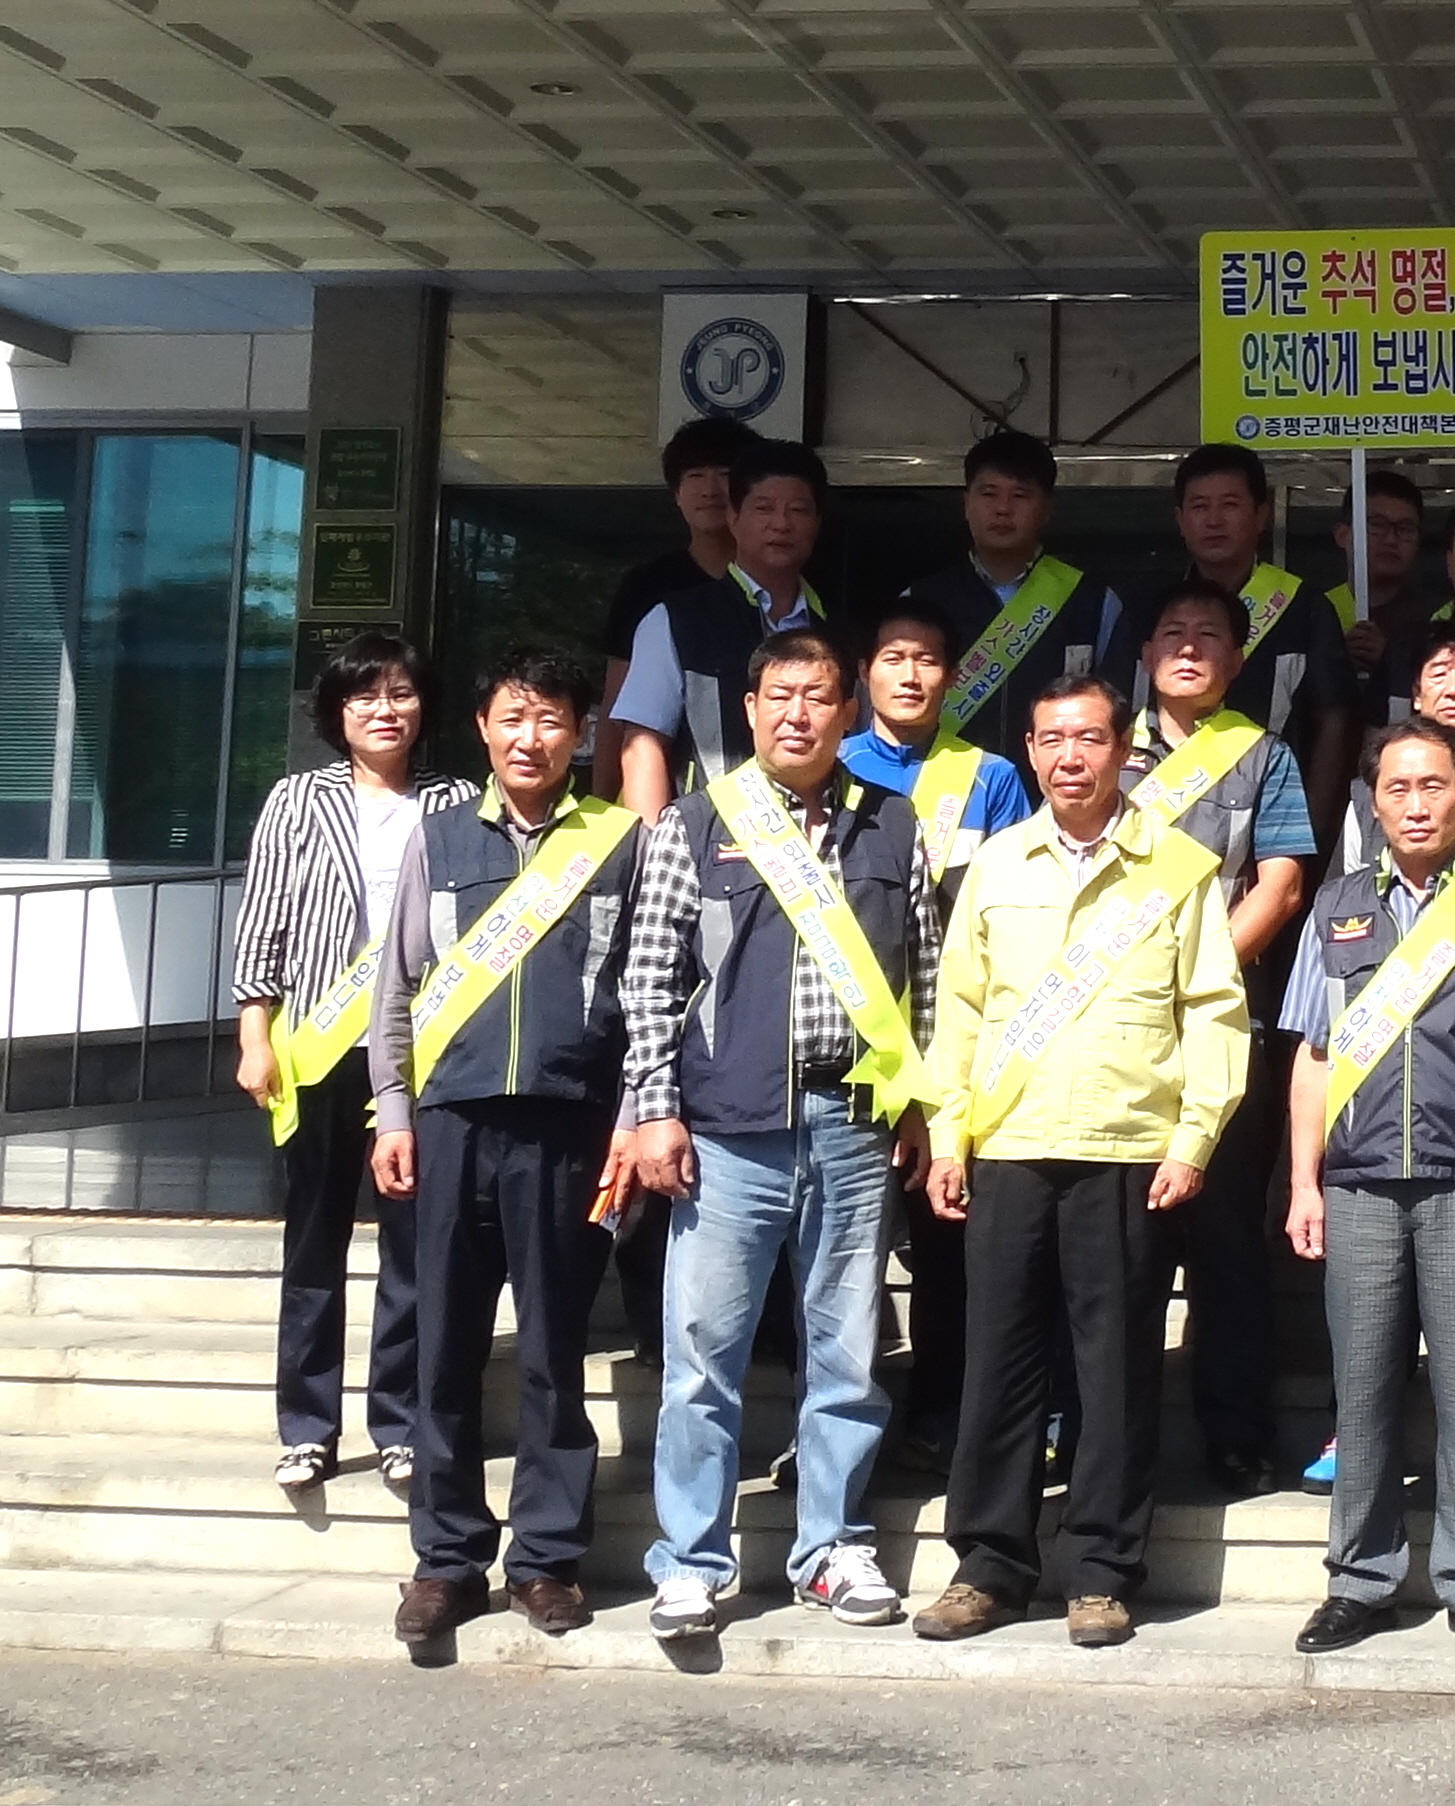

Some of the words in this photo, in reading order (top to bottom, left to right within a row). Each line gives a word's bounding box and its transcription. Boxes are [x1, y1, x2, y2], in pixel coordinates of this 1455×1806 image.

[1221, 250, 1308, 316] 즐거운
[1321, 249, 1377, 314] 추석
[1392, 248, 1455, 315] 명절,
[1242, 331, 1358, 397] 안전하게
[1008, 605, 1052, 659] 장시간
[952, 661, 1005, 721] 외출시
[1166, 769, 1209, 810] 가스
[740, 773, 786, 834] 장시간
[783, 841, 836, 909] 외출시
[466, 875, 546, 961] 안전하게
[535, 855, 592, 922] 즐거운
[489, 924, 535, 973] 명절
[799, 911, 865, 1008] 잠금확인
[1107, 893, 1168, 958] 즐거운
[411, 964, 465, 1034] 보냅시
[1022, 963, 1105, 1057] 고향길은
[1333, 962, 1407, 1054] 안전하게
[1395, 942, 1455, 1013] 즐거운
[984, 973, 1063, 1092] 먼저입니다
[1353, 1018, 1395, 1067] 명절
